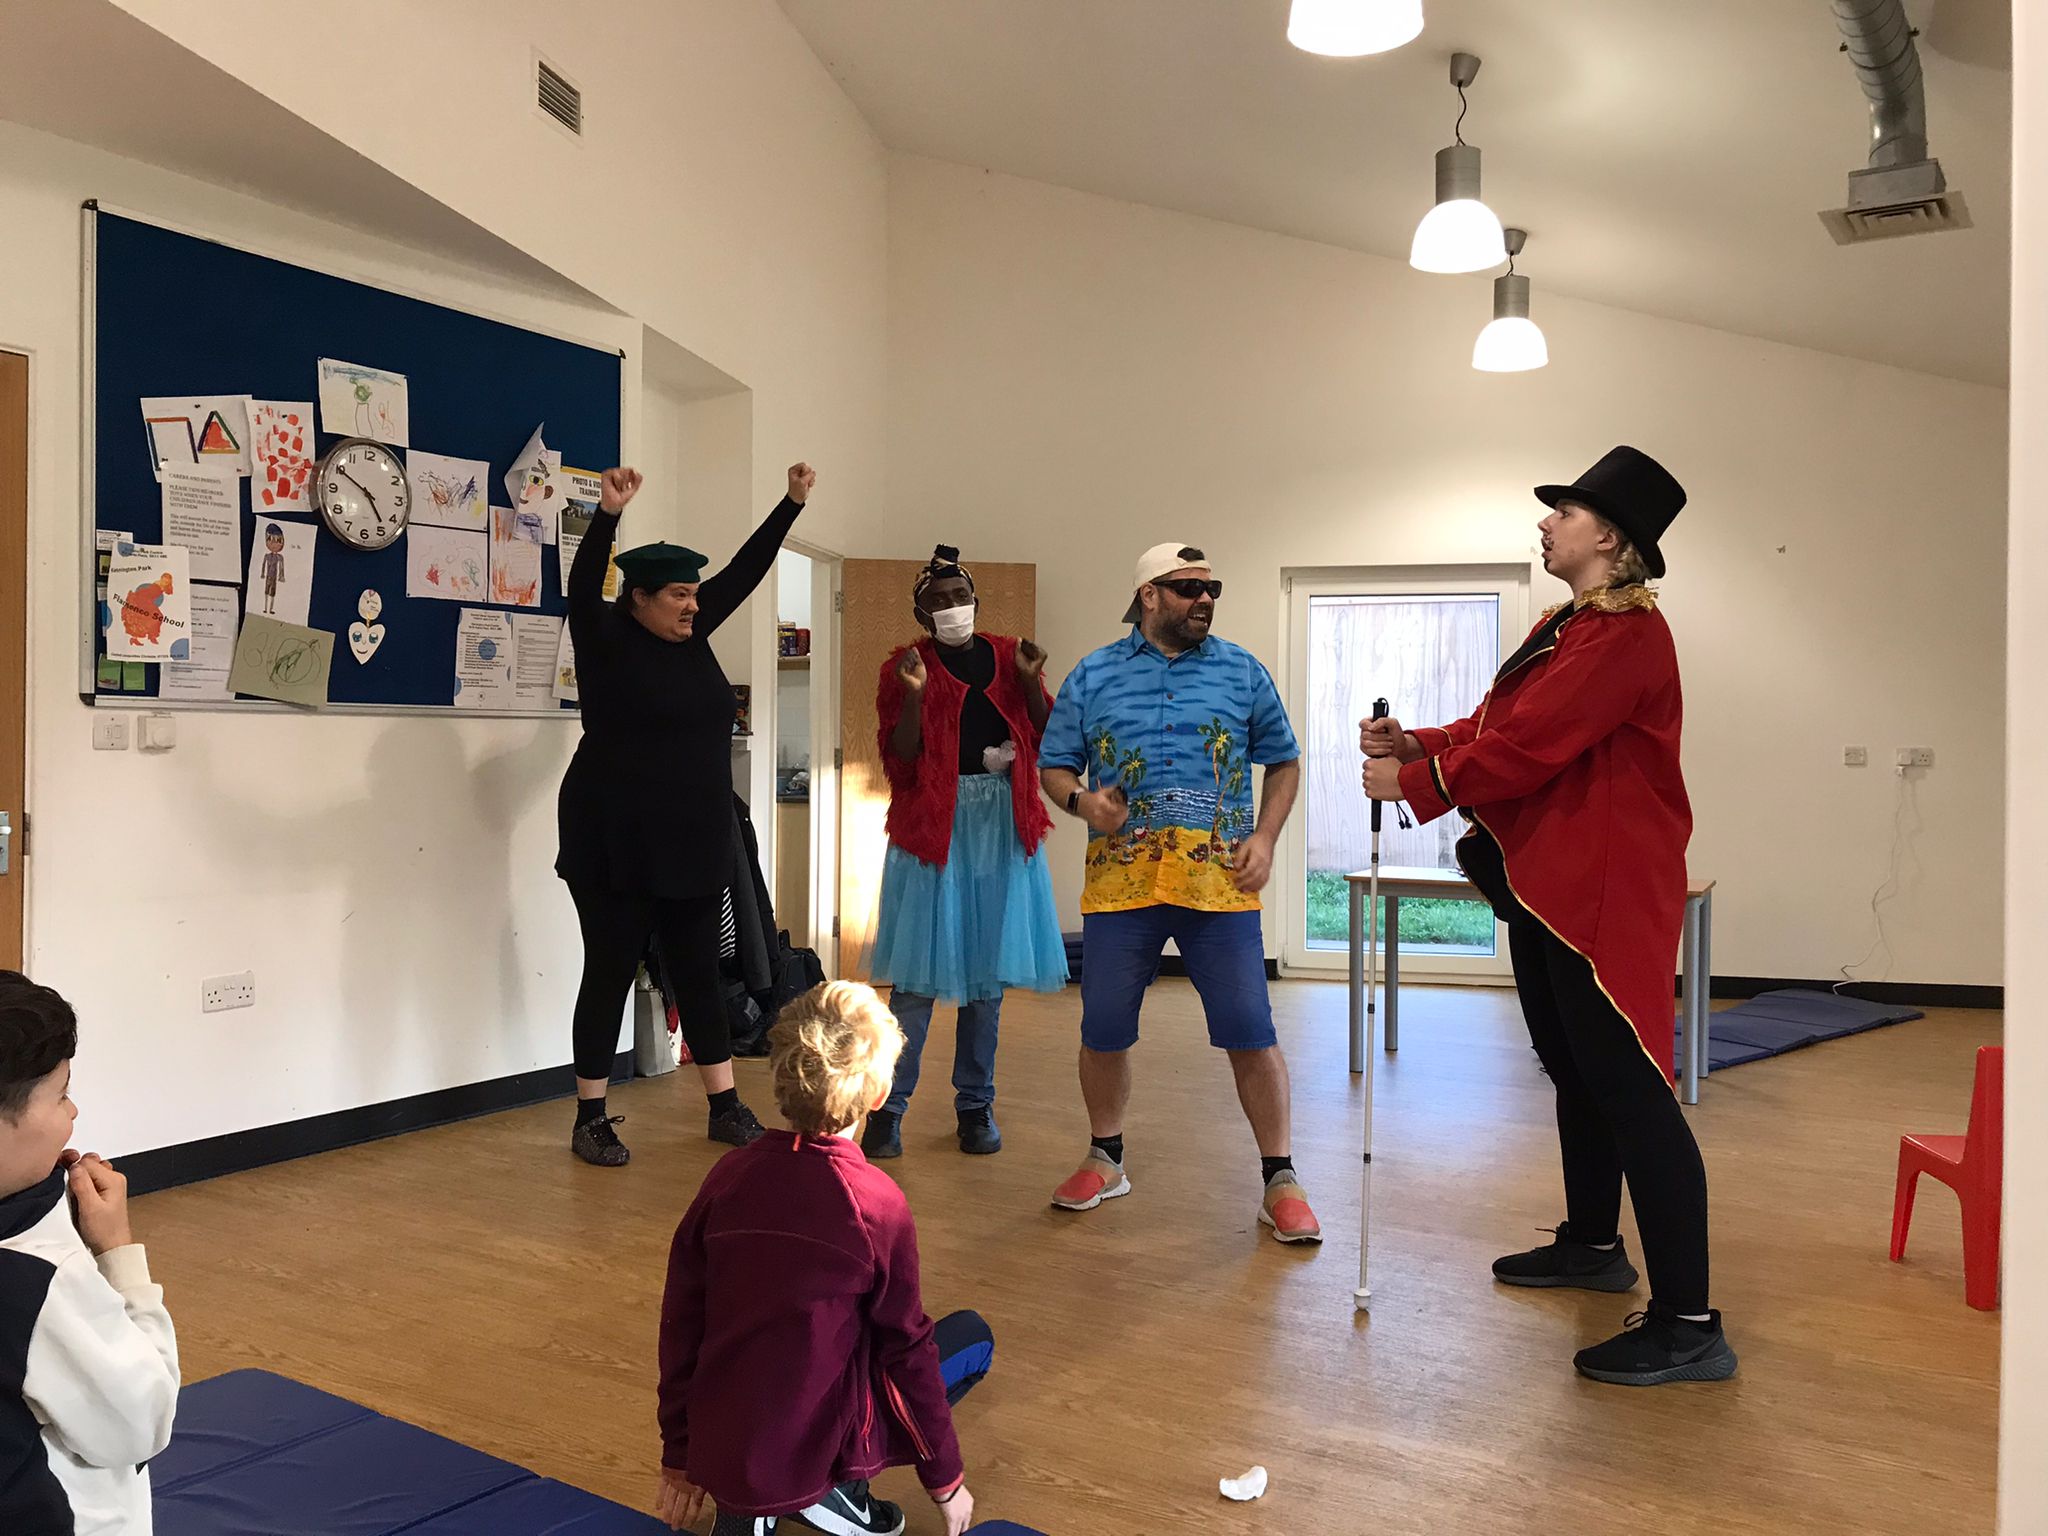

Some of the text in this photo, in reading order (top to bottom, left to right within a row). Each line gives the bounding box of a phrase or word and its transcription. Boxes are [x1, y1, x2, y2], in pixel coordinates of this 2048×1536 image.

[349, 453, 356, 464] 11
[364, 450, 376, 462] 12
[390, 475, 400, 486] 2
[572, 476, 588, 486] PHOTO
[328, 483, 338, 493] 9
[579, 487, 600, 498] TRAINING
[394, 496, 404, 507] 3
[332, 504, 343, 514] 8
[388, 514, 398, 524] 4
[344, 521, 353, 532] 7
[376, 526, 386, 536] 5
[360, 529, 369, 540] 6
[113, 593, 185, 628] Flamenco School
